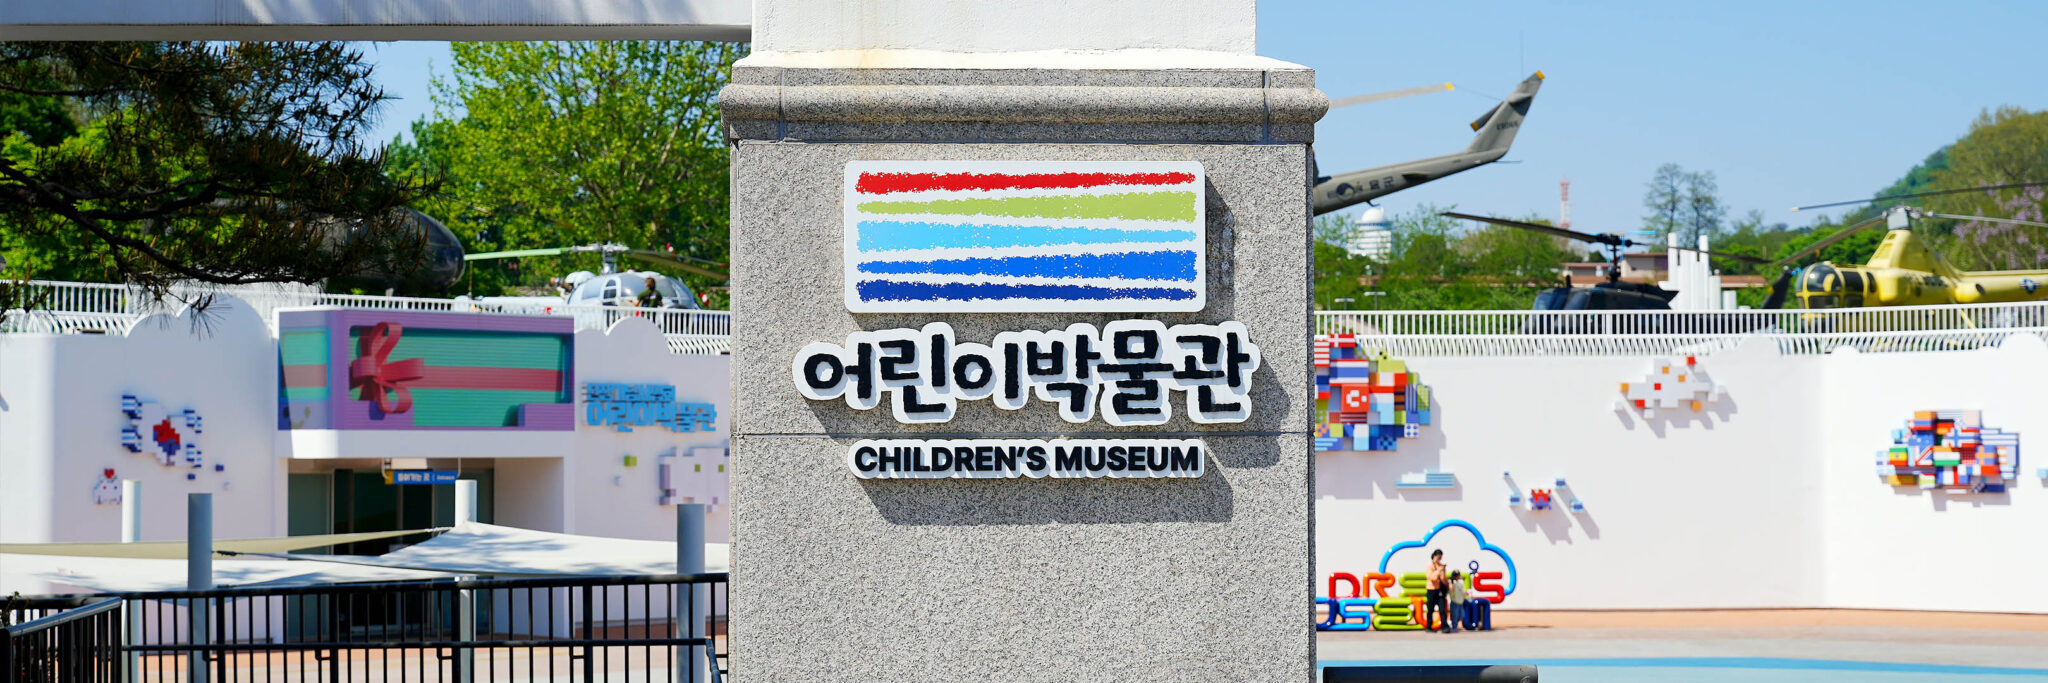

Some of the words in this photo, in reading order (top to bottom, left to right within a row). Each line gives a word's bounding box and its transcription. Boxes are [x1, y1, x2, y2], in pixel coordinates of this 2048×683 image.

[803, 329, 1251, 415] 어린이박물관
[585, 402, 717, 433] 어린이박물관
[854, 444, 1047, 473] CHILDREN'S
[1054, 445, 1199, 472] MUSEUM
[1328, 572, 1505, 604] DRES
[1316, 597, 1492, 631] USEUM
